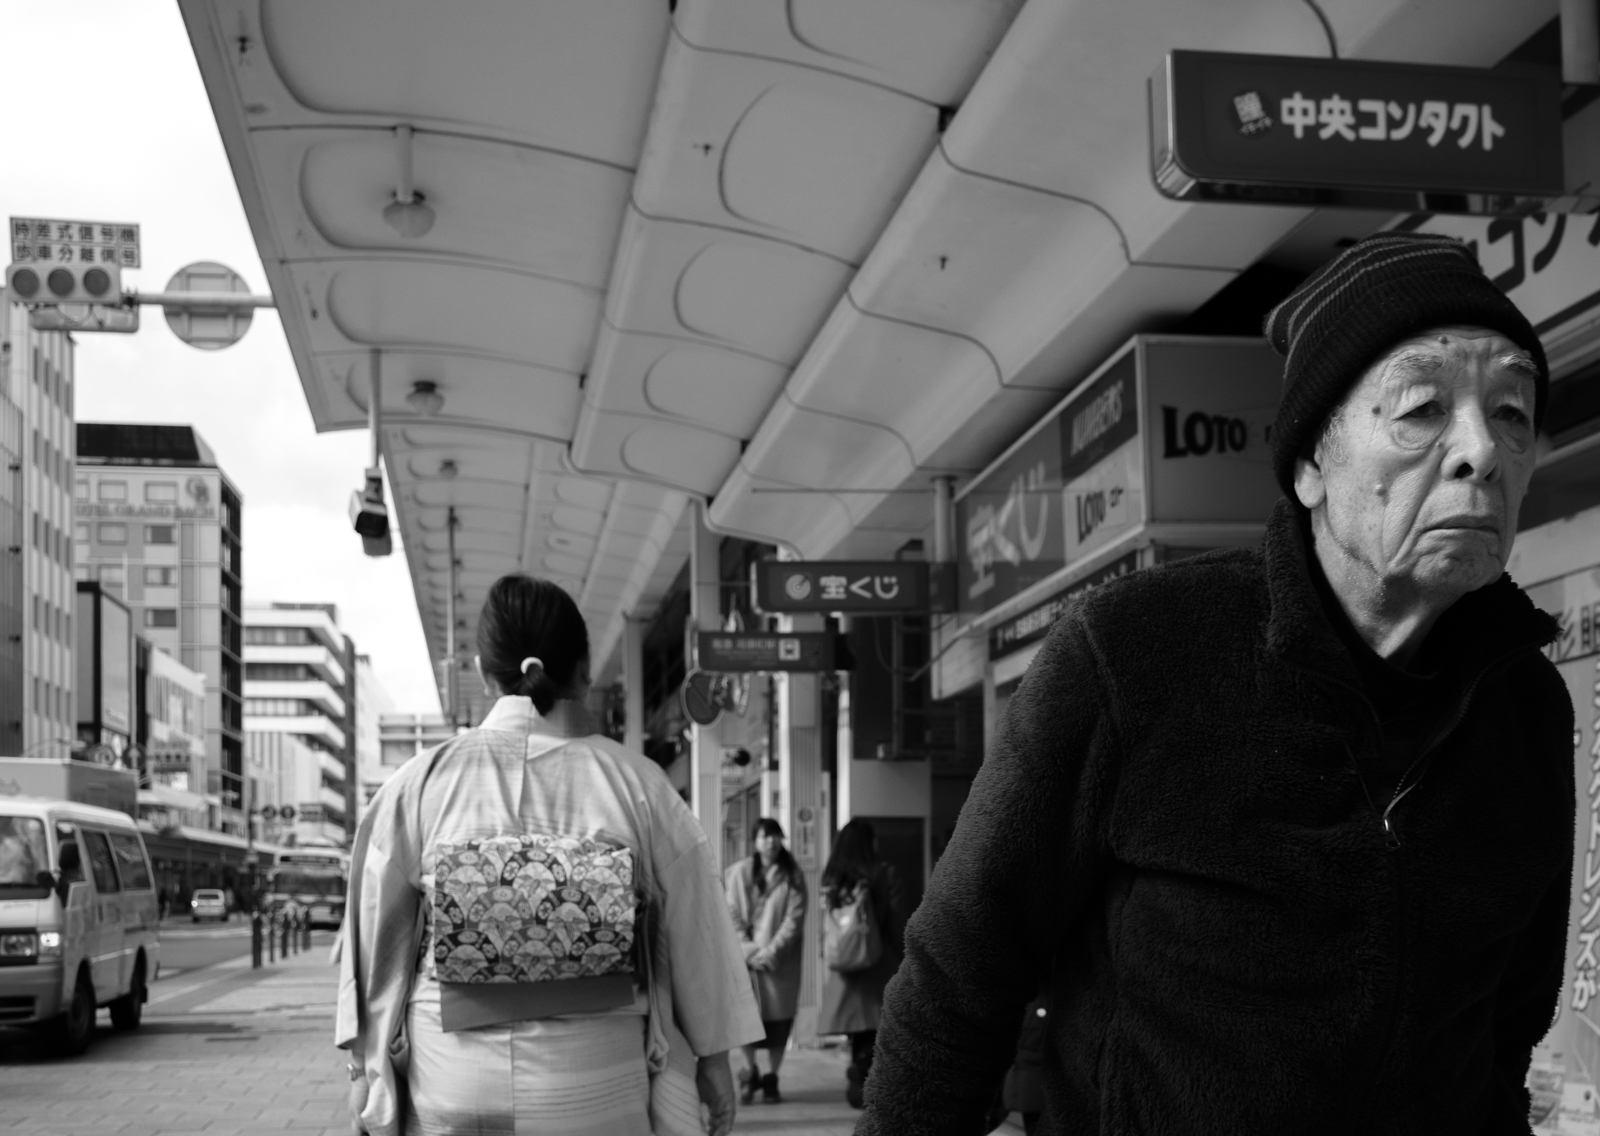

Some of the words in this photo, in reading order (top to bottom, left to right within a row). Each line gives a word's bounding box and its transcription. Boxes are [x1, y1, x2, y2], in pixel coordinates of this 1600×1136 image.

[1280, 92, 1506, 151] 中央コンタクト
[15, 222, 136, 242] 時差式信号機
[15, 242, 136, 264] 歩車分離信号
[1161, 404, 1248, 460] LOTO
[1076, 491, 1106, 545] LOTO
[818, 575, 900, 600] 宝くじ
